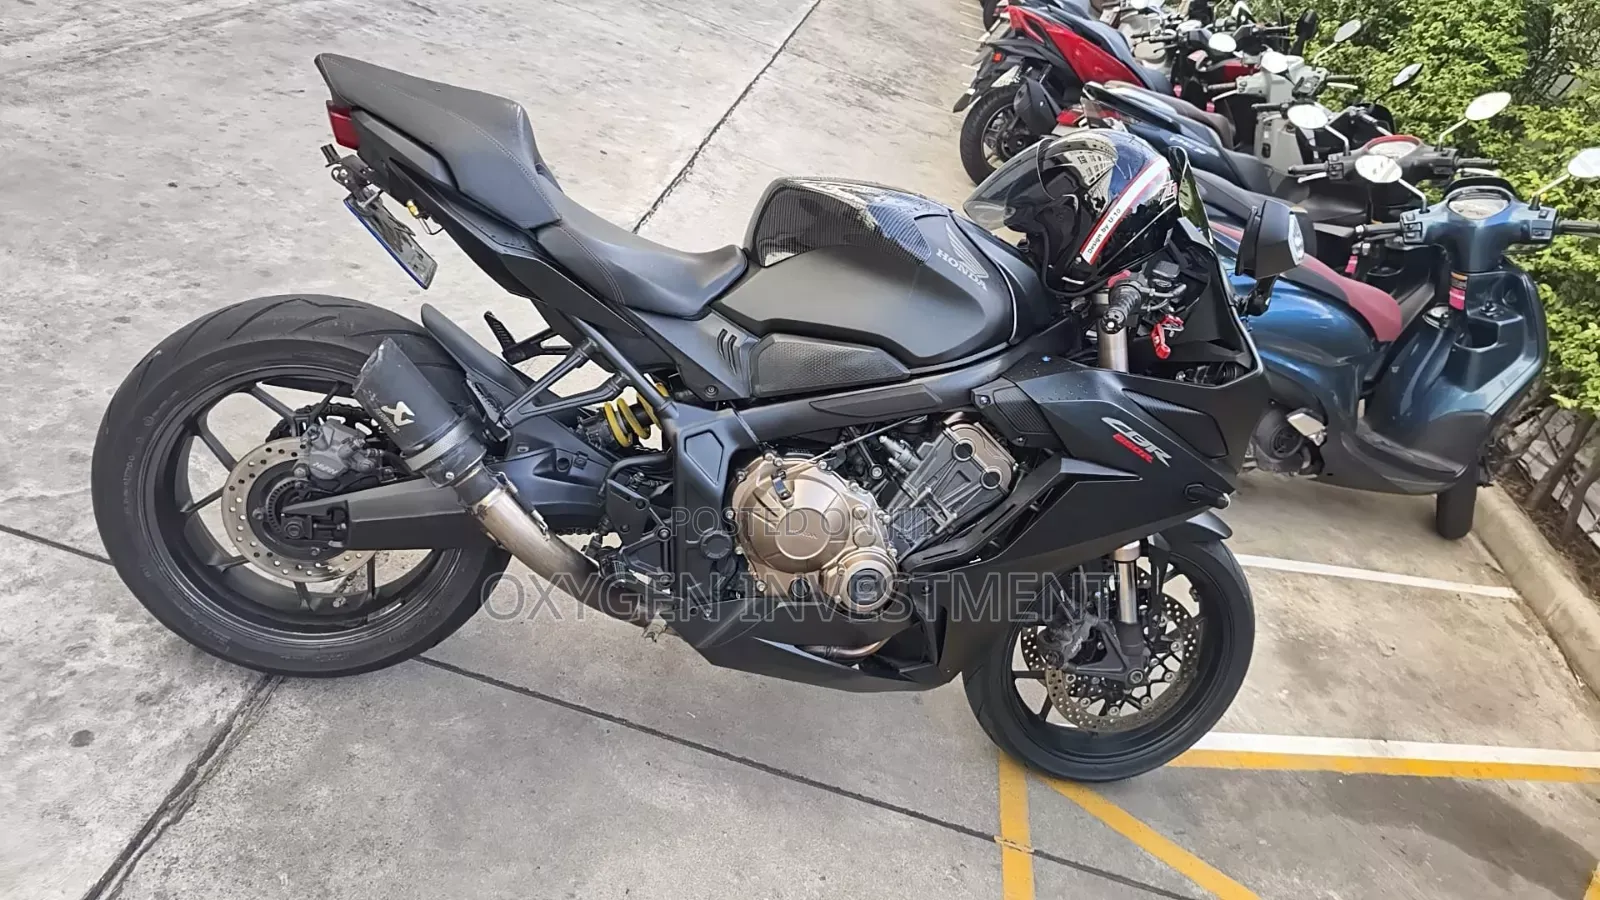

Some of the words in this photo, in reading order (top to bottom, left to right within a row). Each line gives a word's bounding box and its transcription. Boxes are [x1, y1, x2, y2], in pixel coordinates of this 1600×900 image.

[1087, 234, 1102, 254] Design
[1101, 223, 1110, 233] by
[936, 248, 988, 292] HONDA
[1101, 417, 1172, 467] CBR
